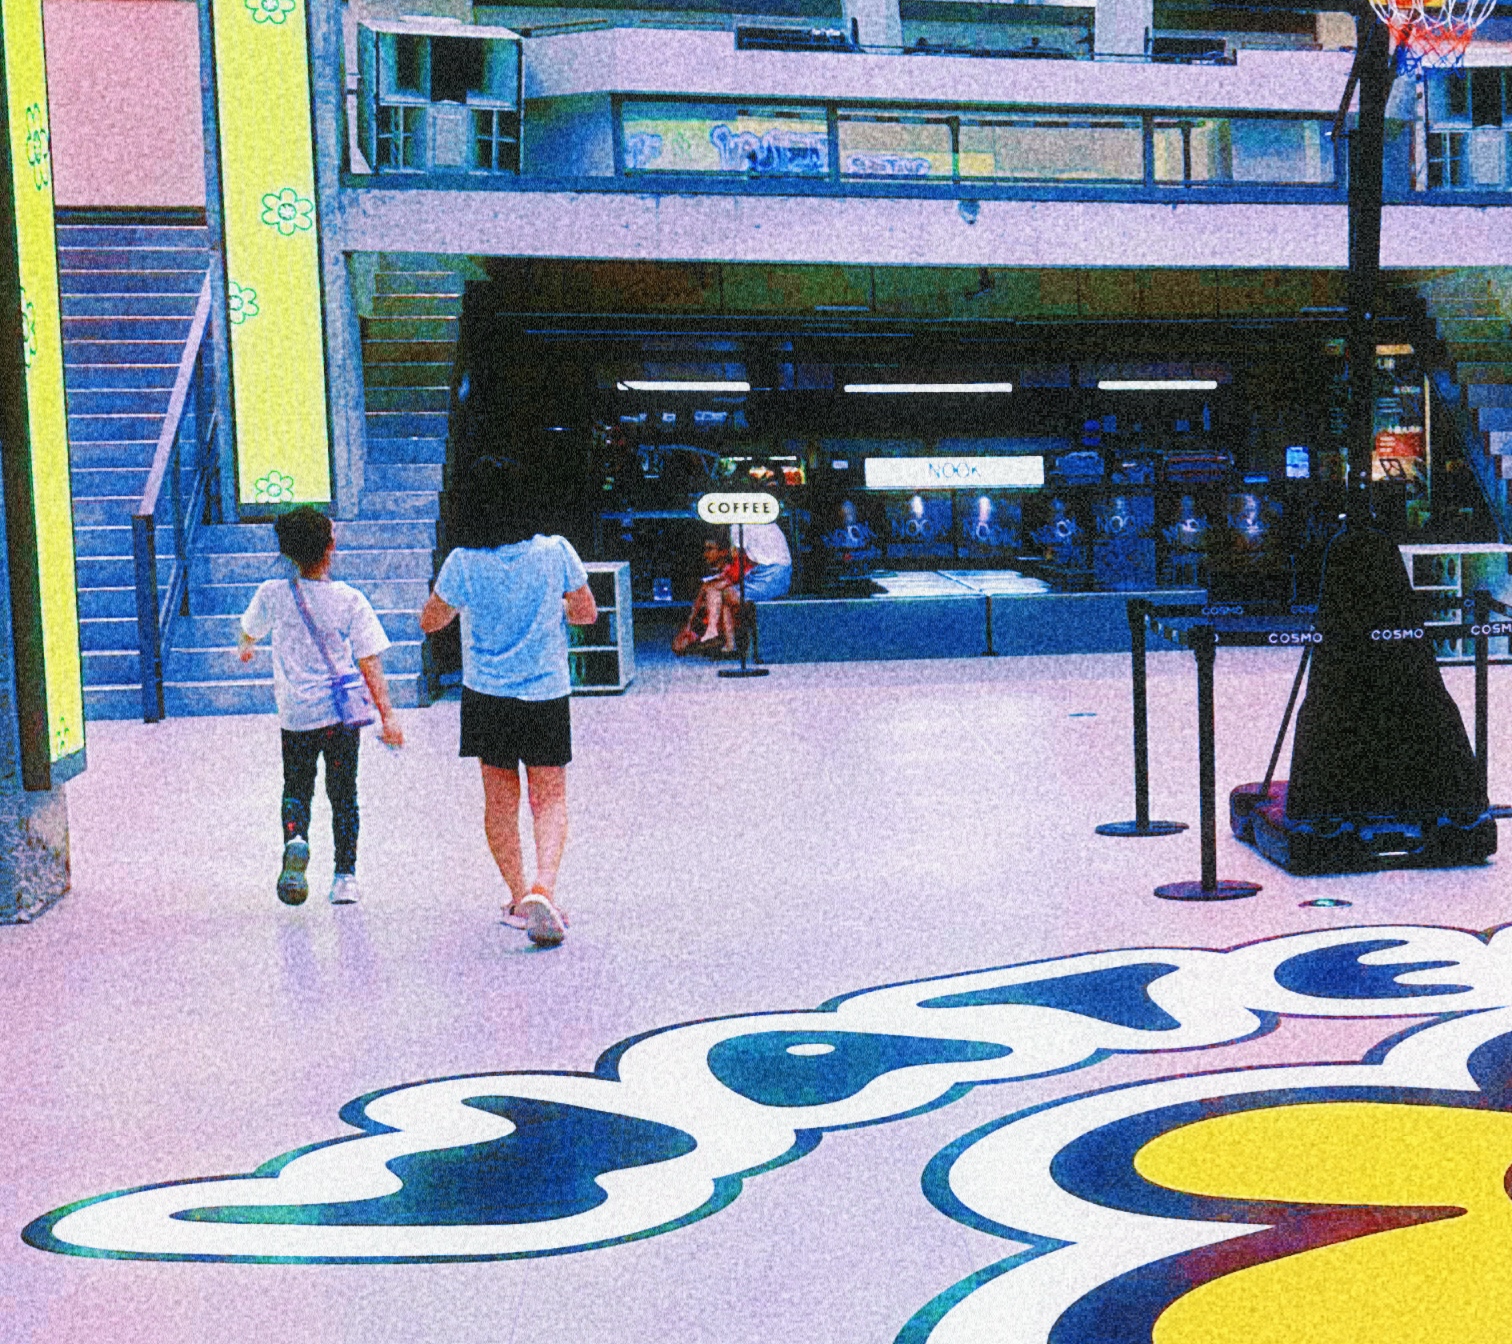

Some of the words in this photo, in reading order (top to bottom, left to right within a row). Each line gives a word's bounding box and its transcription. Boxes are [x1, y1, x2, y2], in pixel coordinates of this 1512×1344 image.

[928, 462, 982, 479] NOOK
[707, 502, 770, 514] COFFEE
[1290, 605, 1318, 614] COS
[1268, 632, 1323, 643] COSMO
[1371, 628, 1424, 640] COSMO
